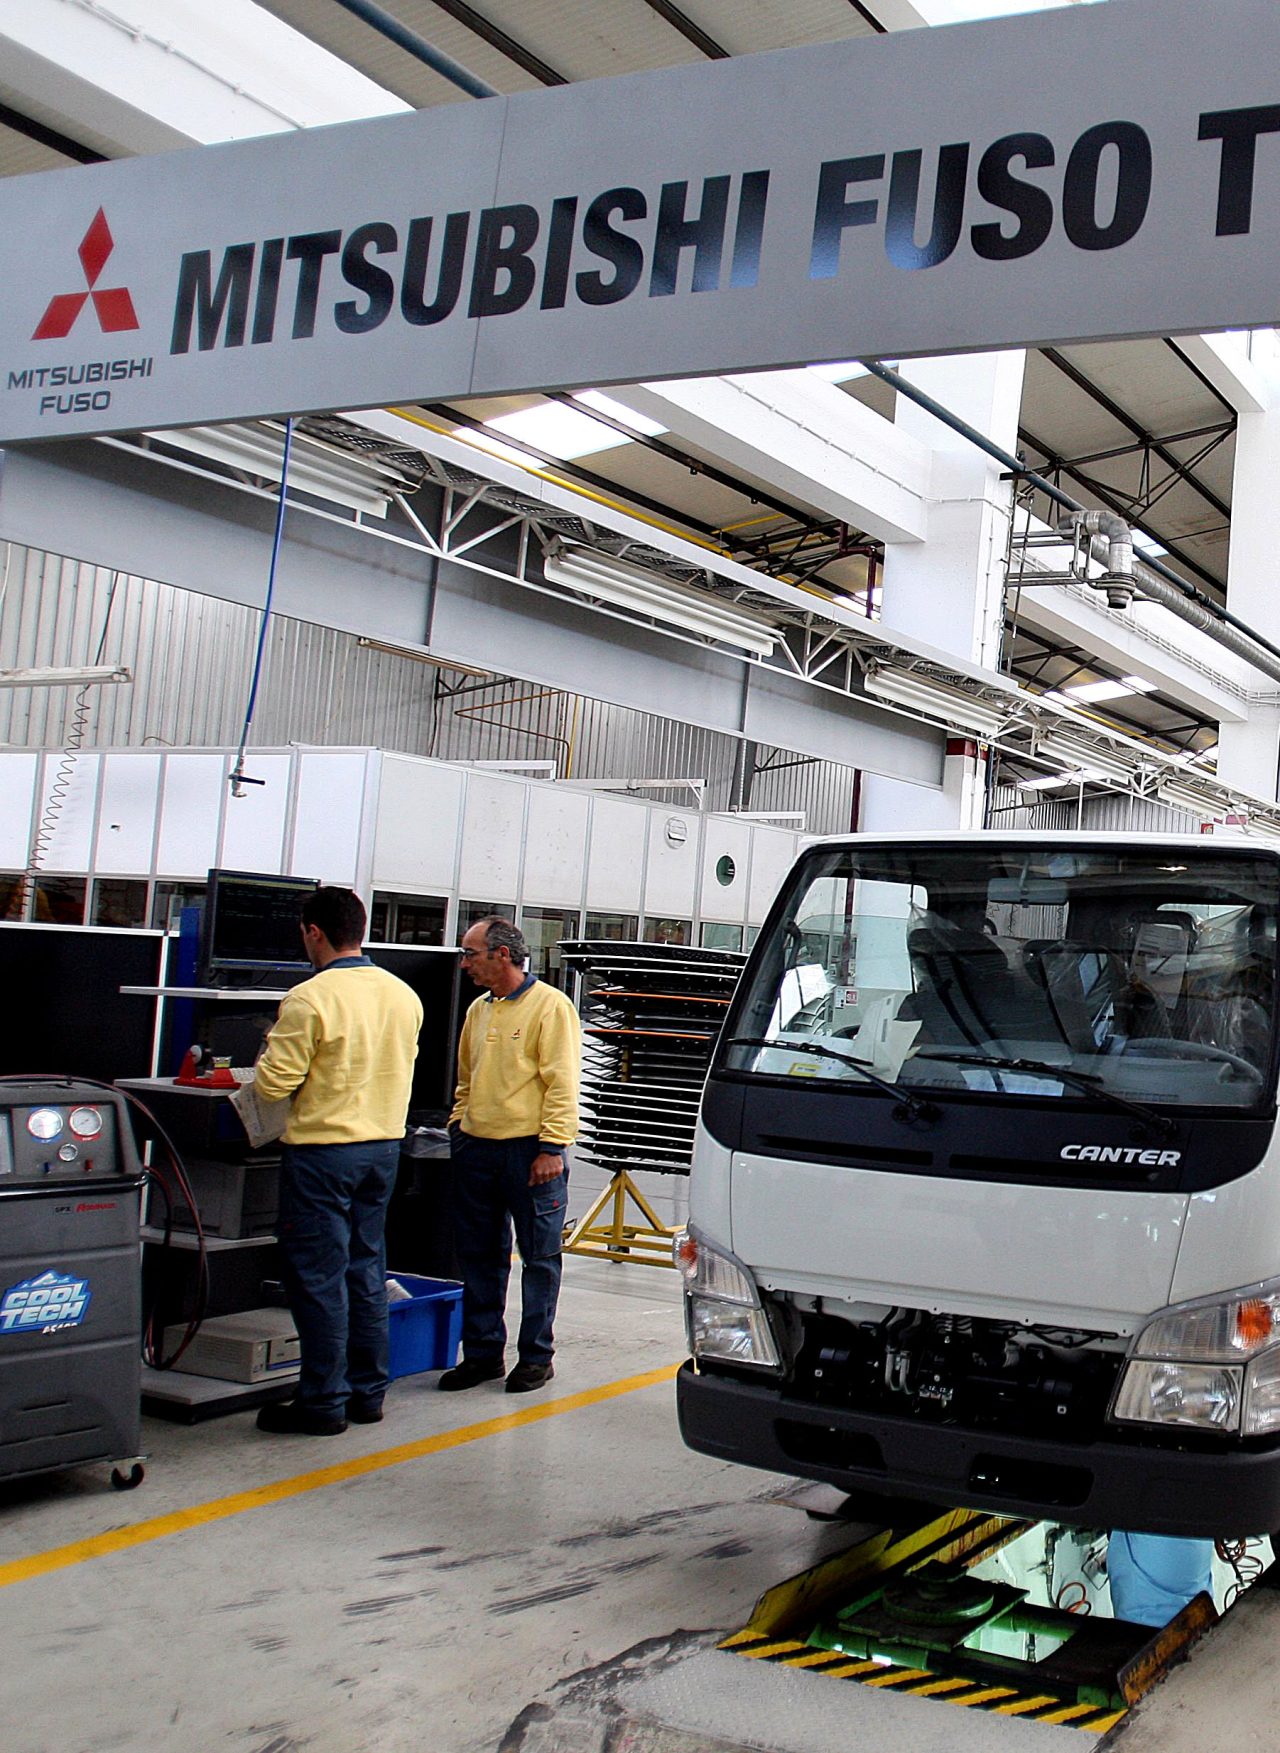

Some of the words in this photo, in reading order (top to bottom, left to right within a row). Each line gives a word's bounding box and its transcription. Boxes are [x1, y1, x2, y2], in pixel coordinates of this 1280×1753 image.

[169, 169, 770, 355] MITSUBISHI
[808, 119, 1153, 282] FUSO
[7, 356, 153, 390] MITSUBISHI
[39, 390, 111, 416] FUSO
[1060, 1144, 1182, 1167] CANTER
[5, 1282, 87, 1309] COOL
[0, 1301, 84, 1330] TECH
